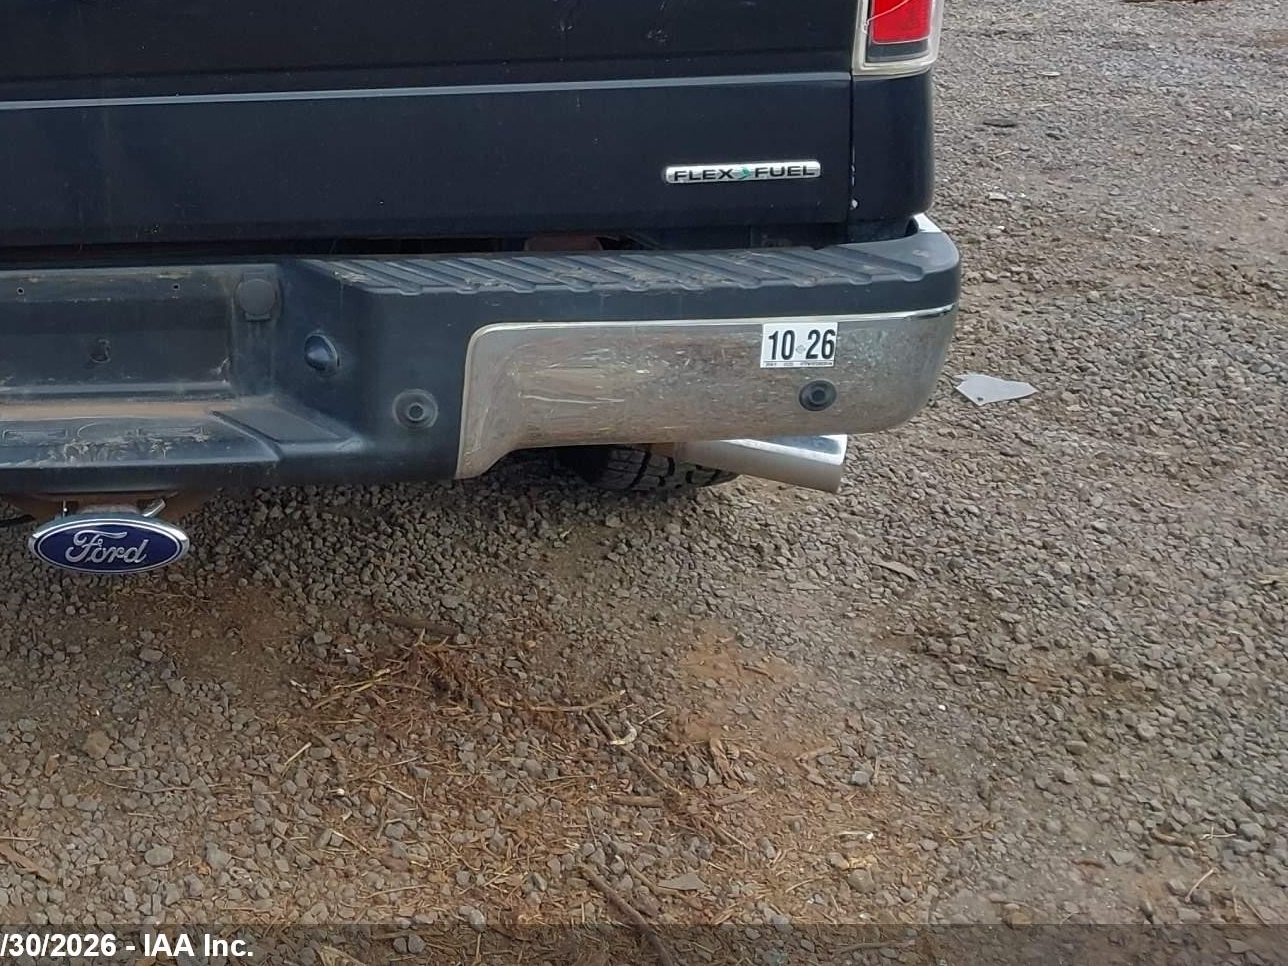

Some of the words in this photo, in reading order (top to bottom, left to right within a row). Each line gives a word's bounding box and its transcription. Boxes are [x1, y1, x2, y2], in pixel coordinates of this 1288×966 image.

[674, 168, 734, 181] FLEX
[754, 165, 816, 178] FUEL
[768, 329, 796, 360] 10
[805, 329, 836, 360] 26
[65, 529, 149, 563] Ford
